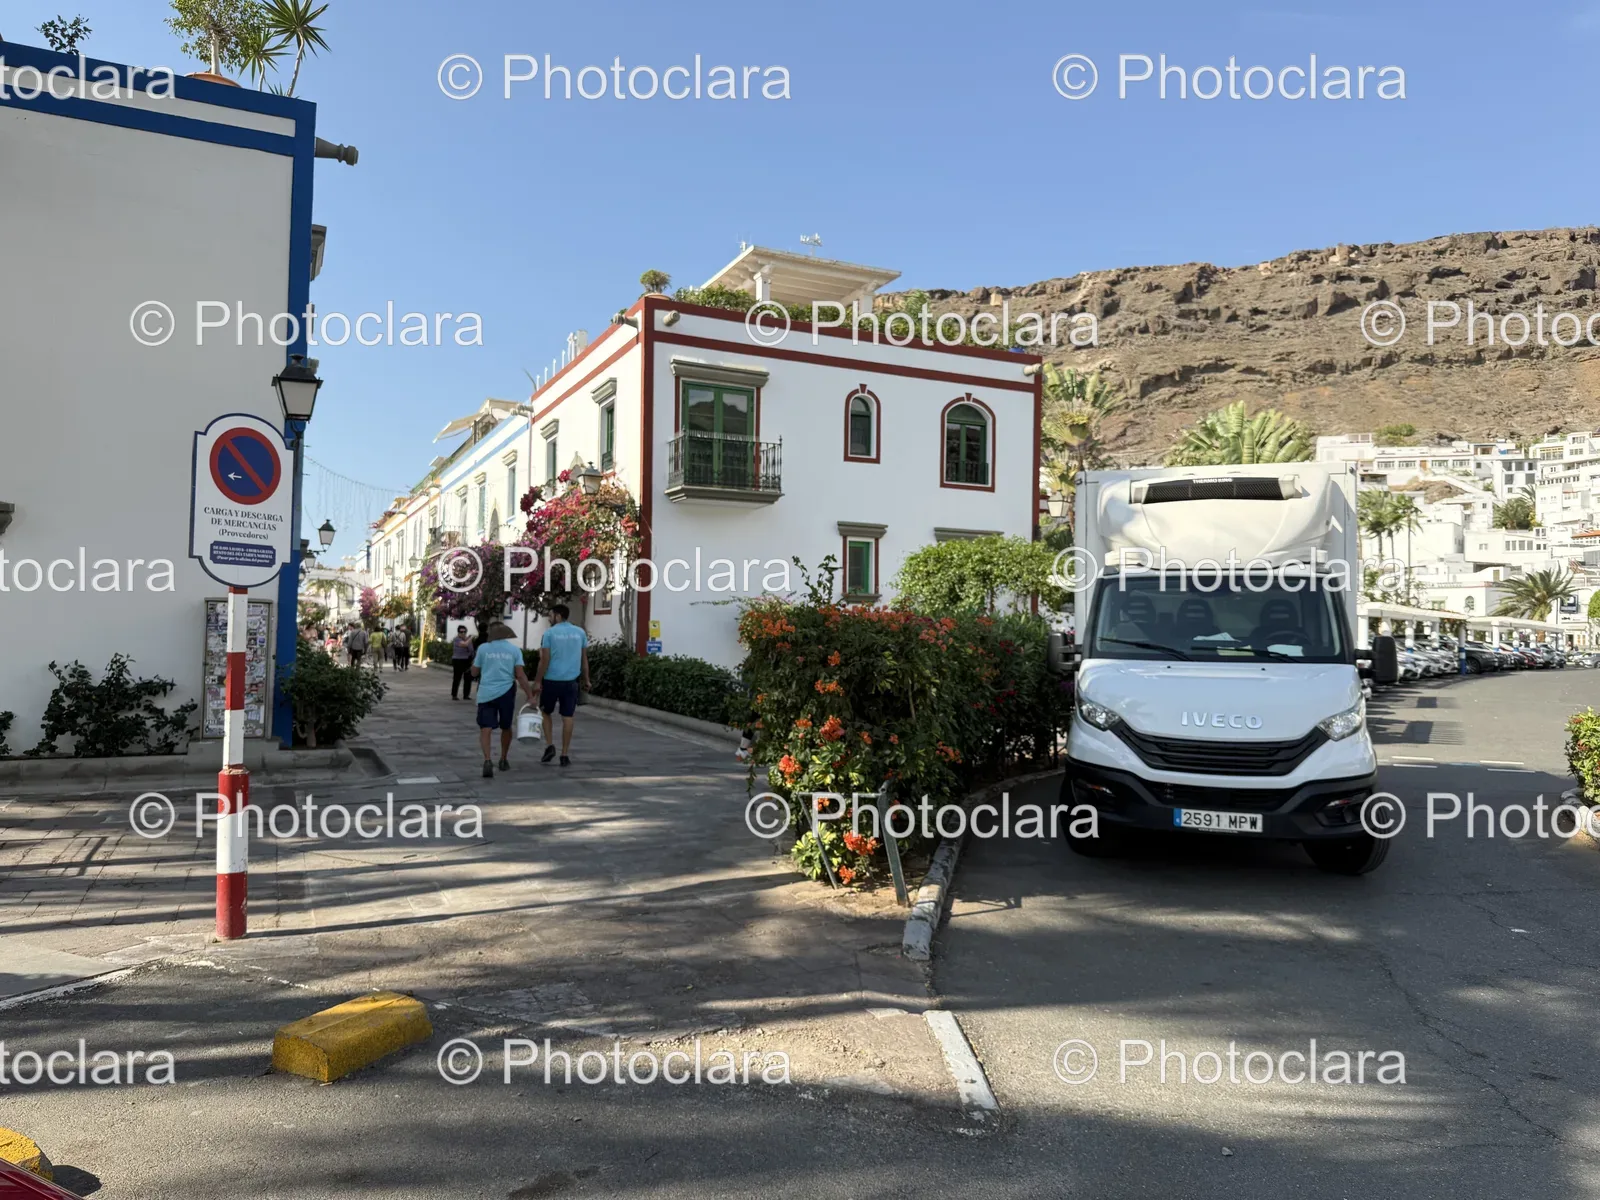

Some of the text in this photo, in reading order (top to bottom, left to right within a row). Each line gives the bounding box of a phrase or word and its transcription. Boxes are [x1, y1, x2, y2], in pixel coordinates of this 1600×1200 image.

[204, 506, 284, 522] CARGA Y DESCARGA
[211, 517, 277, 531] DE MERCANCÍAS
[218, 528, 269, 540] (Proveedores)
[1181, 711, 1263, 730] IVECO
[1183, 811, 1258, 830] 2591 MPW
